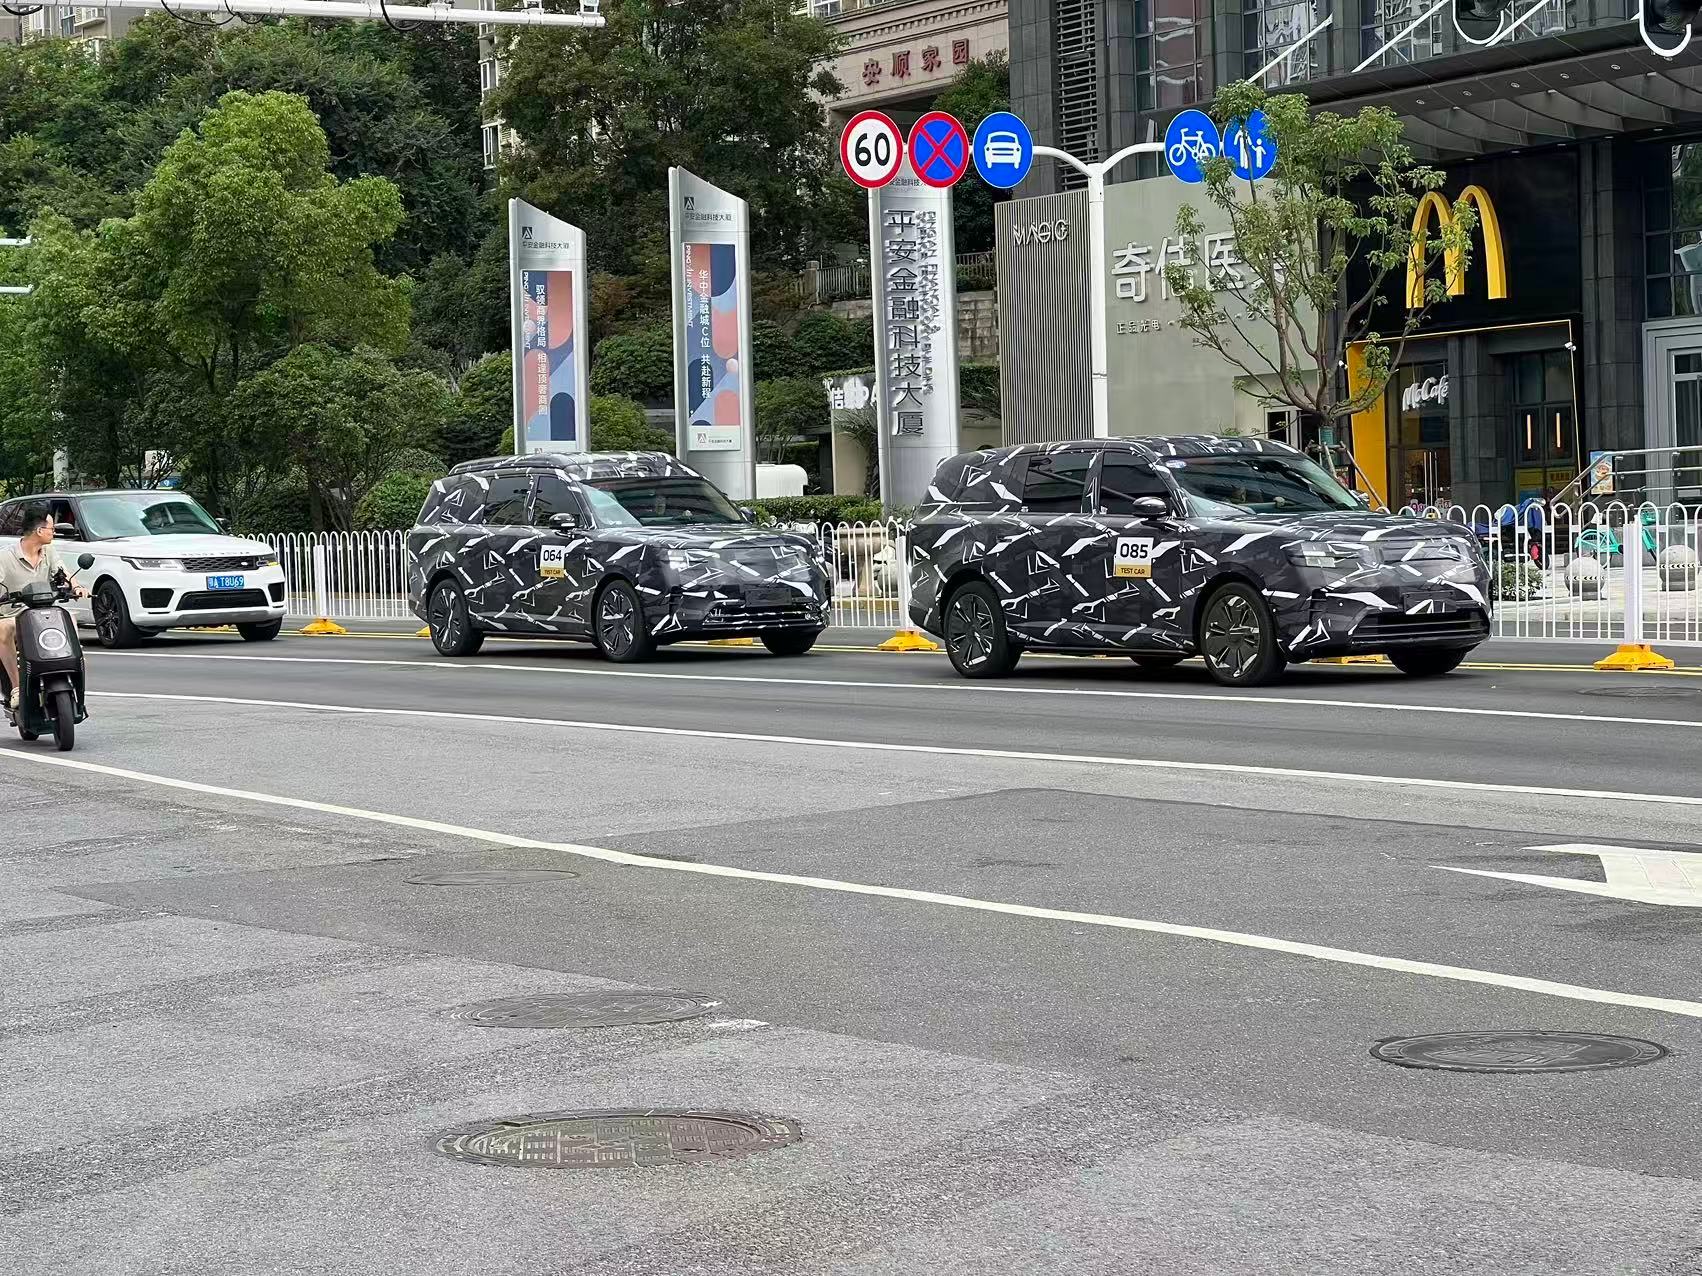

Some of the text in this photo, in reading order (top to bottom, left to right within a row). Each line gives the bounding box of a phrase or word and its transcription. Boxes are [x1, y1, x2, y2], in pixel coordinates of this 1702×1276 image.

[862, 38, 969, 86] 安顺家园
[855, 132, 890, 167] 60
[686, 279, 694, 328] INVESTMENT
[928, 264, 940, 319] FINANCIAL
[699, 269, 711, 399] 华中金融城C位 共赴新程
[885, 209, 924, 435] 平安金融科技大厦
[1402, 374, 1449, 411] McCafé
[543, 549, 562, 561] 064
[1120, 543, 1148, 558] 085
